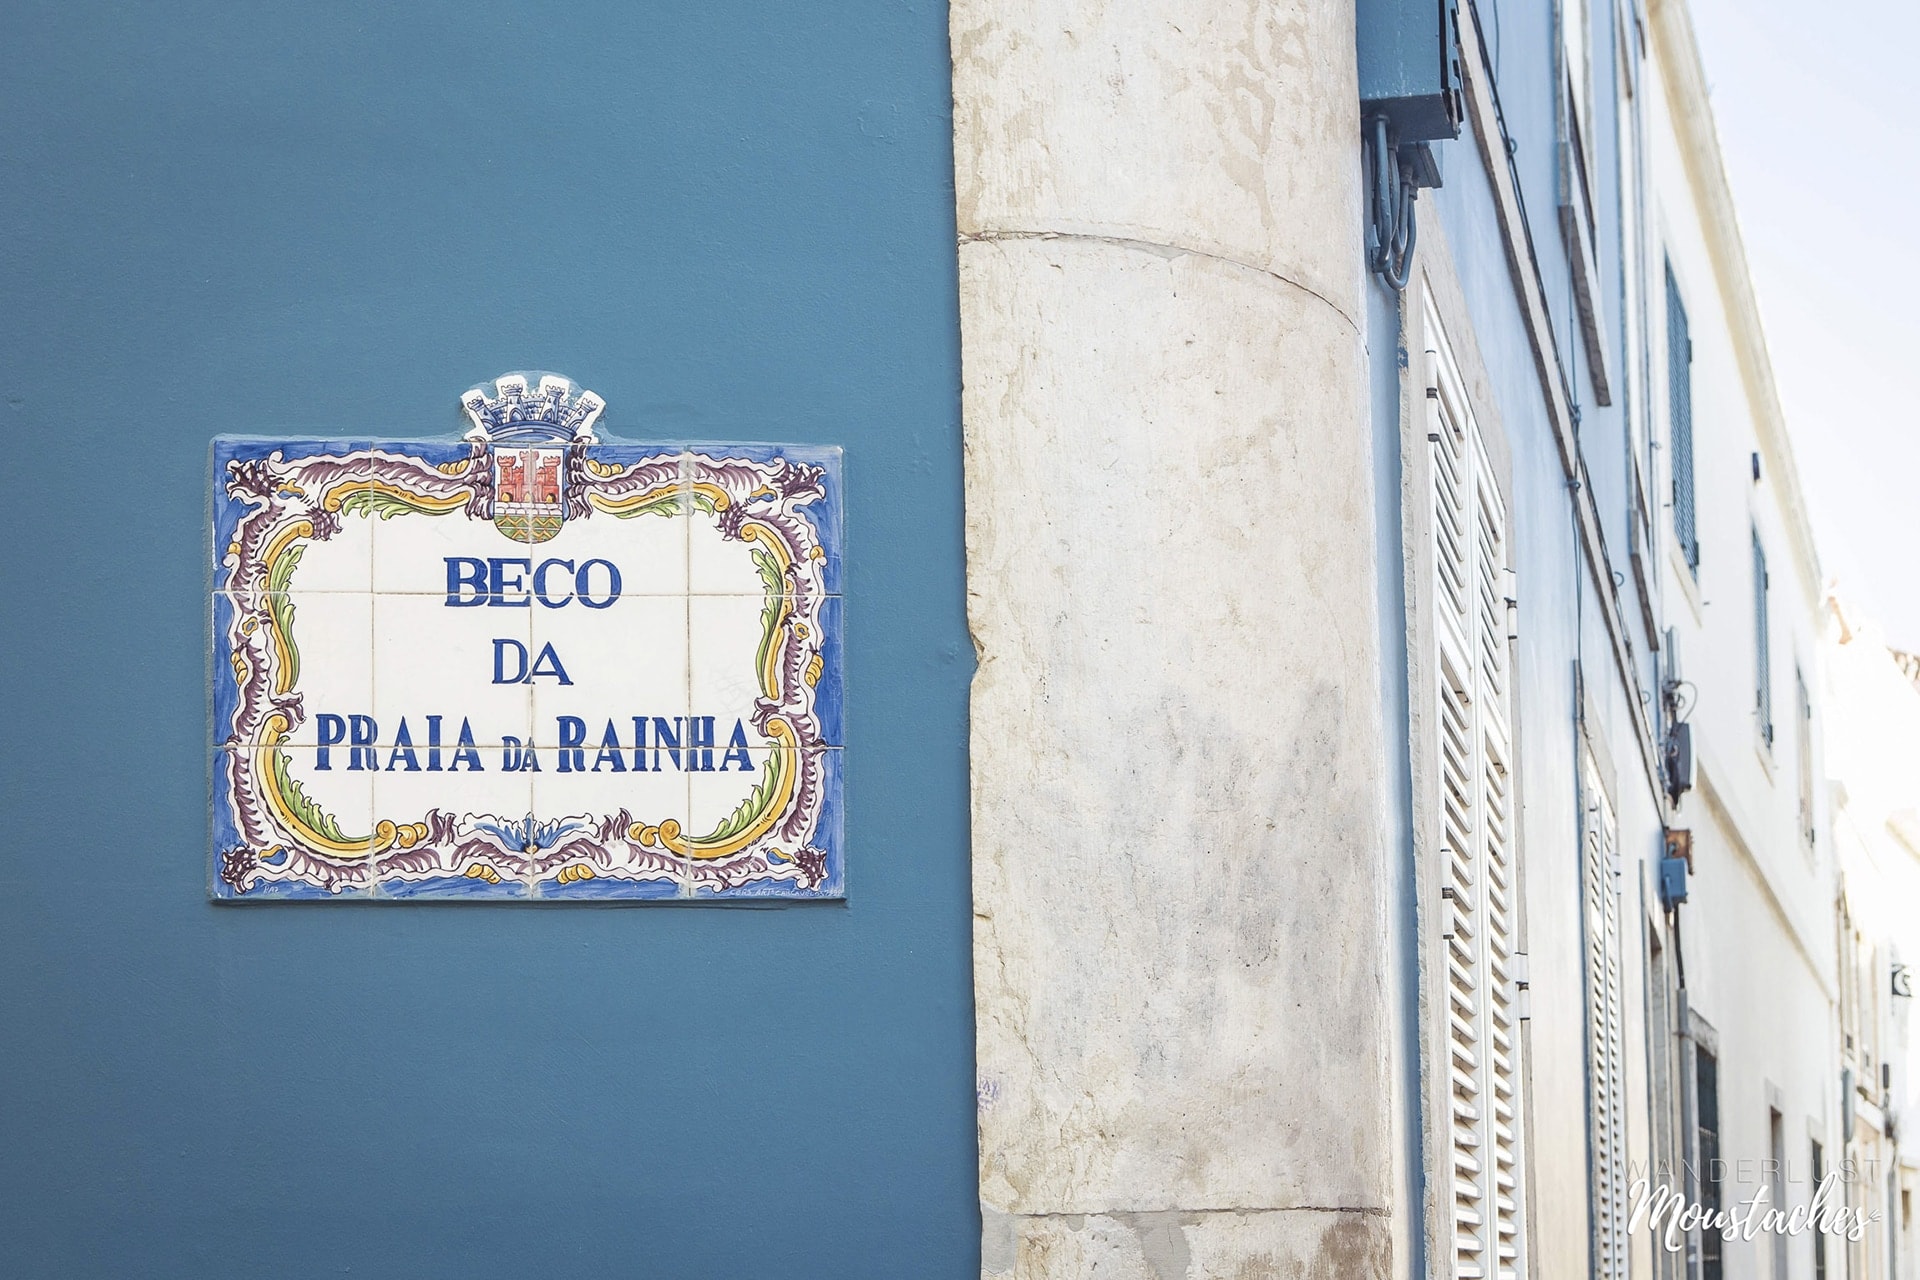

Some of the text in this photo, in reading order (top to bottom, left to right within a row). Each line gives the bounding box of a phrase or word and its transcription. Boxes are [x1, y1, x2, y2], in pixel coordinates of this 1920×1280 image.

[443, 557, 622, 609] BECO
[492, 638, 574, 685] DA
[314, 713, 755, 772] PRAIA DA RAINHA
